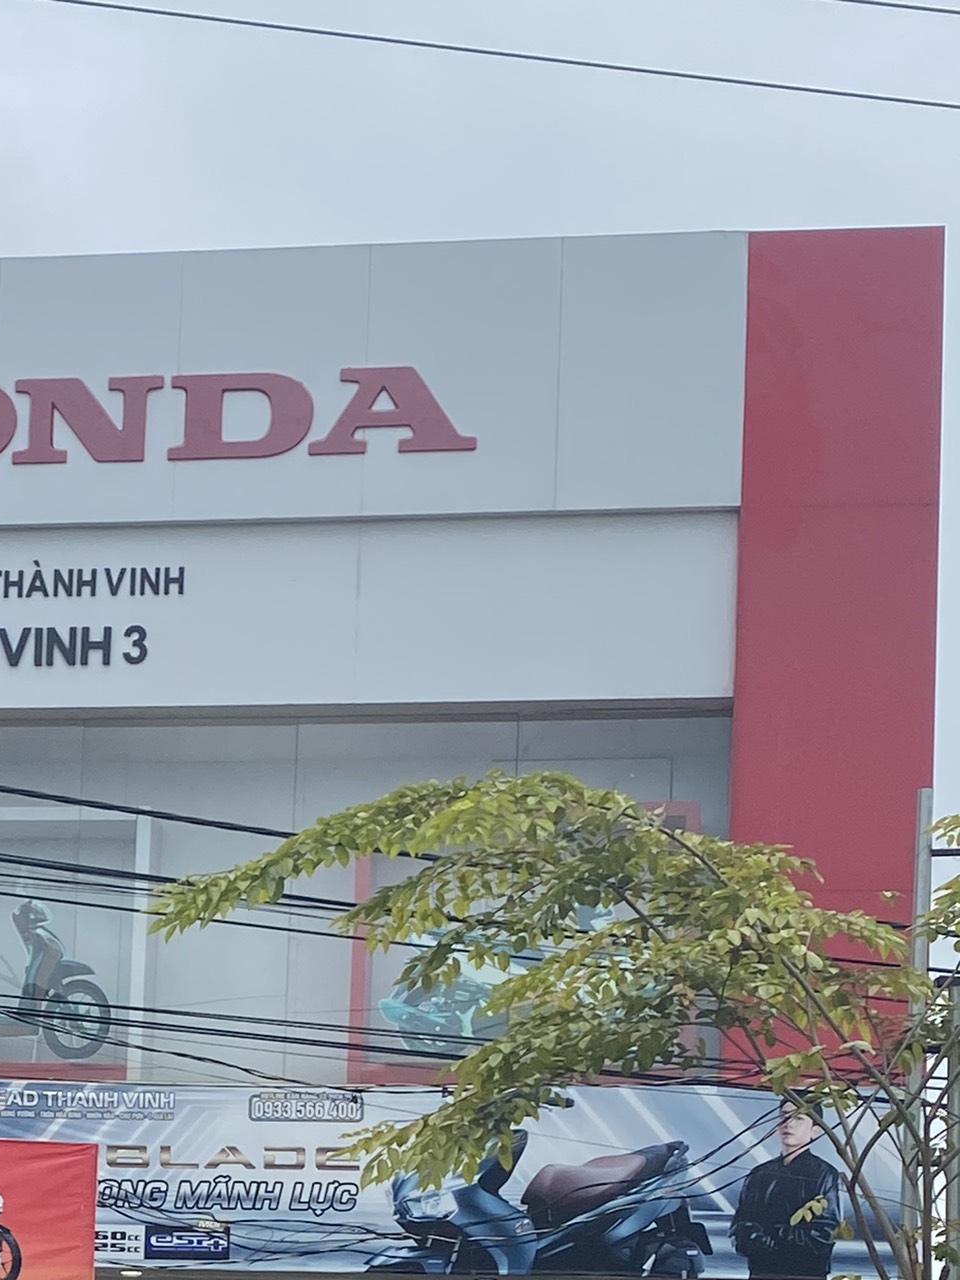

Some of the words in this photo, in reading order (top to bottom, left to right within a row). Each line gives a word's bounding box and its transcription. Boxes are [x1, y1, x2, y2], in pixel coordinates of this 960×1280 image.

[105, 567, 185, 596] VINH
[122, 625, 148, 665] 3
[42, 1088, 117, 1108] THÀNH
[122, 1092, 174, 1108] VINH
[254, 1101, 291, 1117] 0933
[297, 1101, 324, 1118] 566
[328, 1102, 357, 1118] 400
[106, 1145, 360, 1171] BLADE
[175, 1175, 283, 1211] MÃNH
[289, 1180, 359, 1217] LỰC
